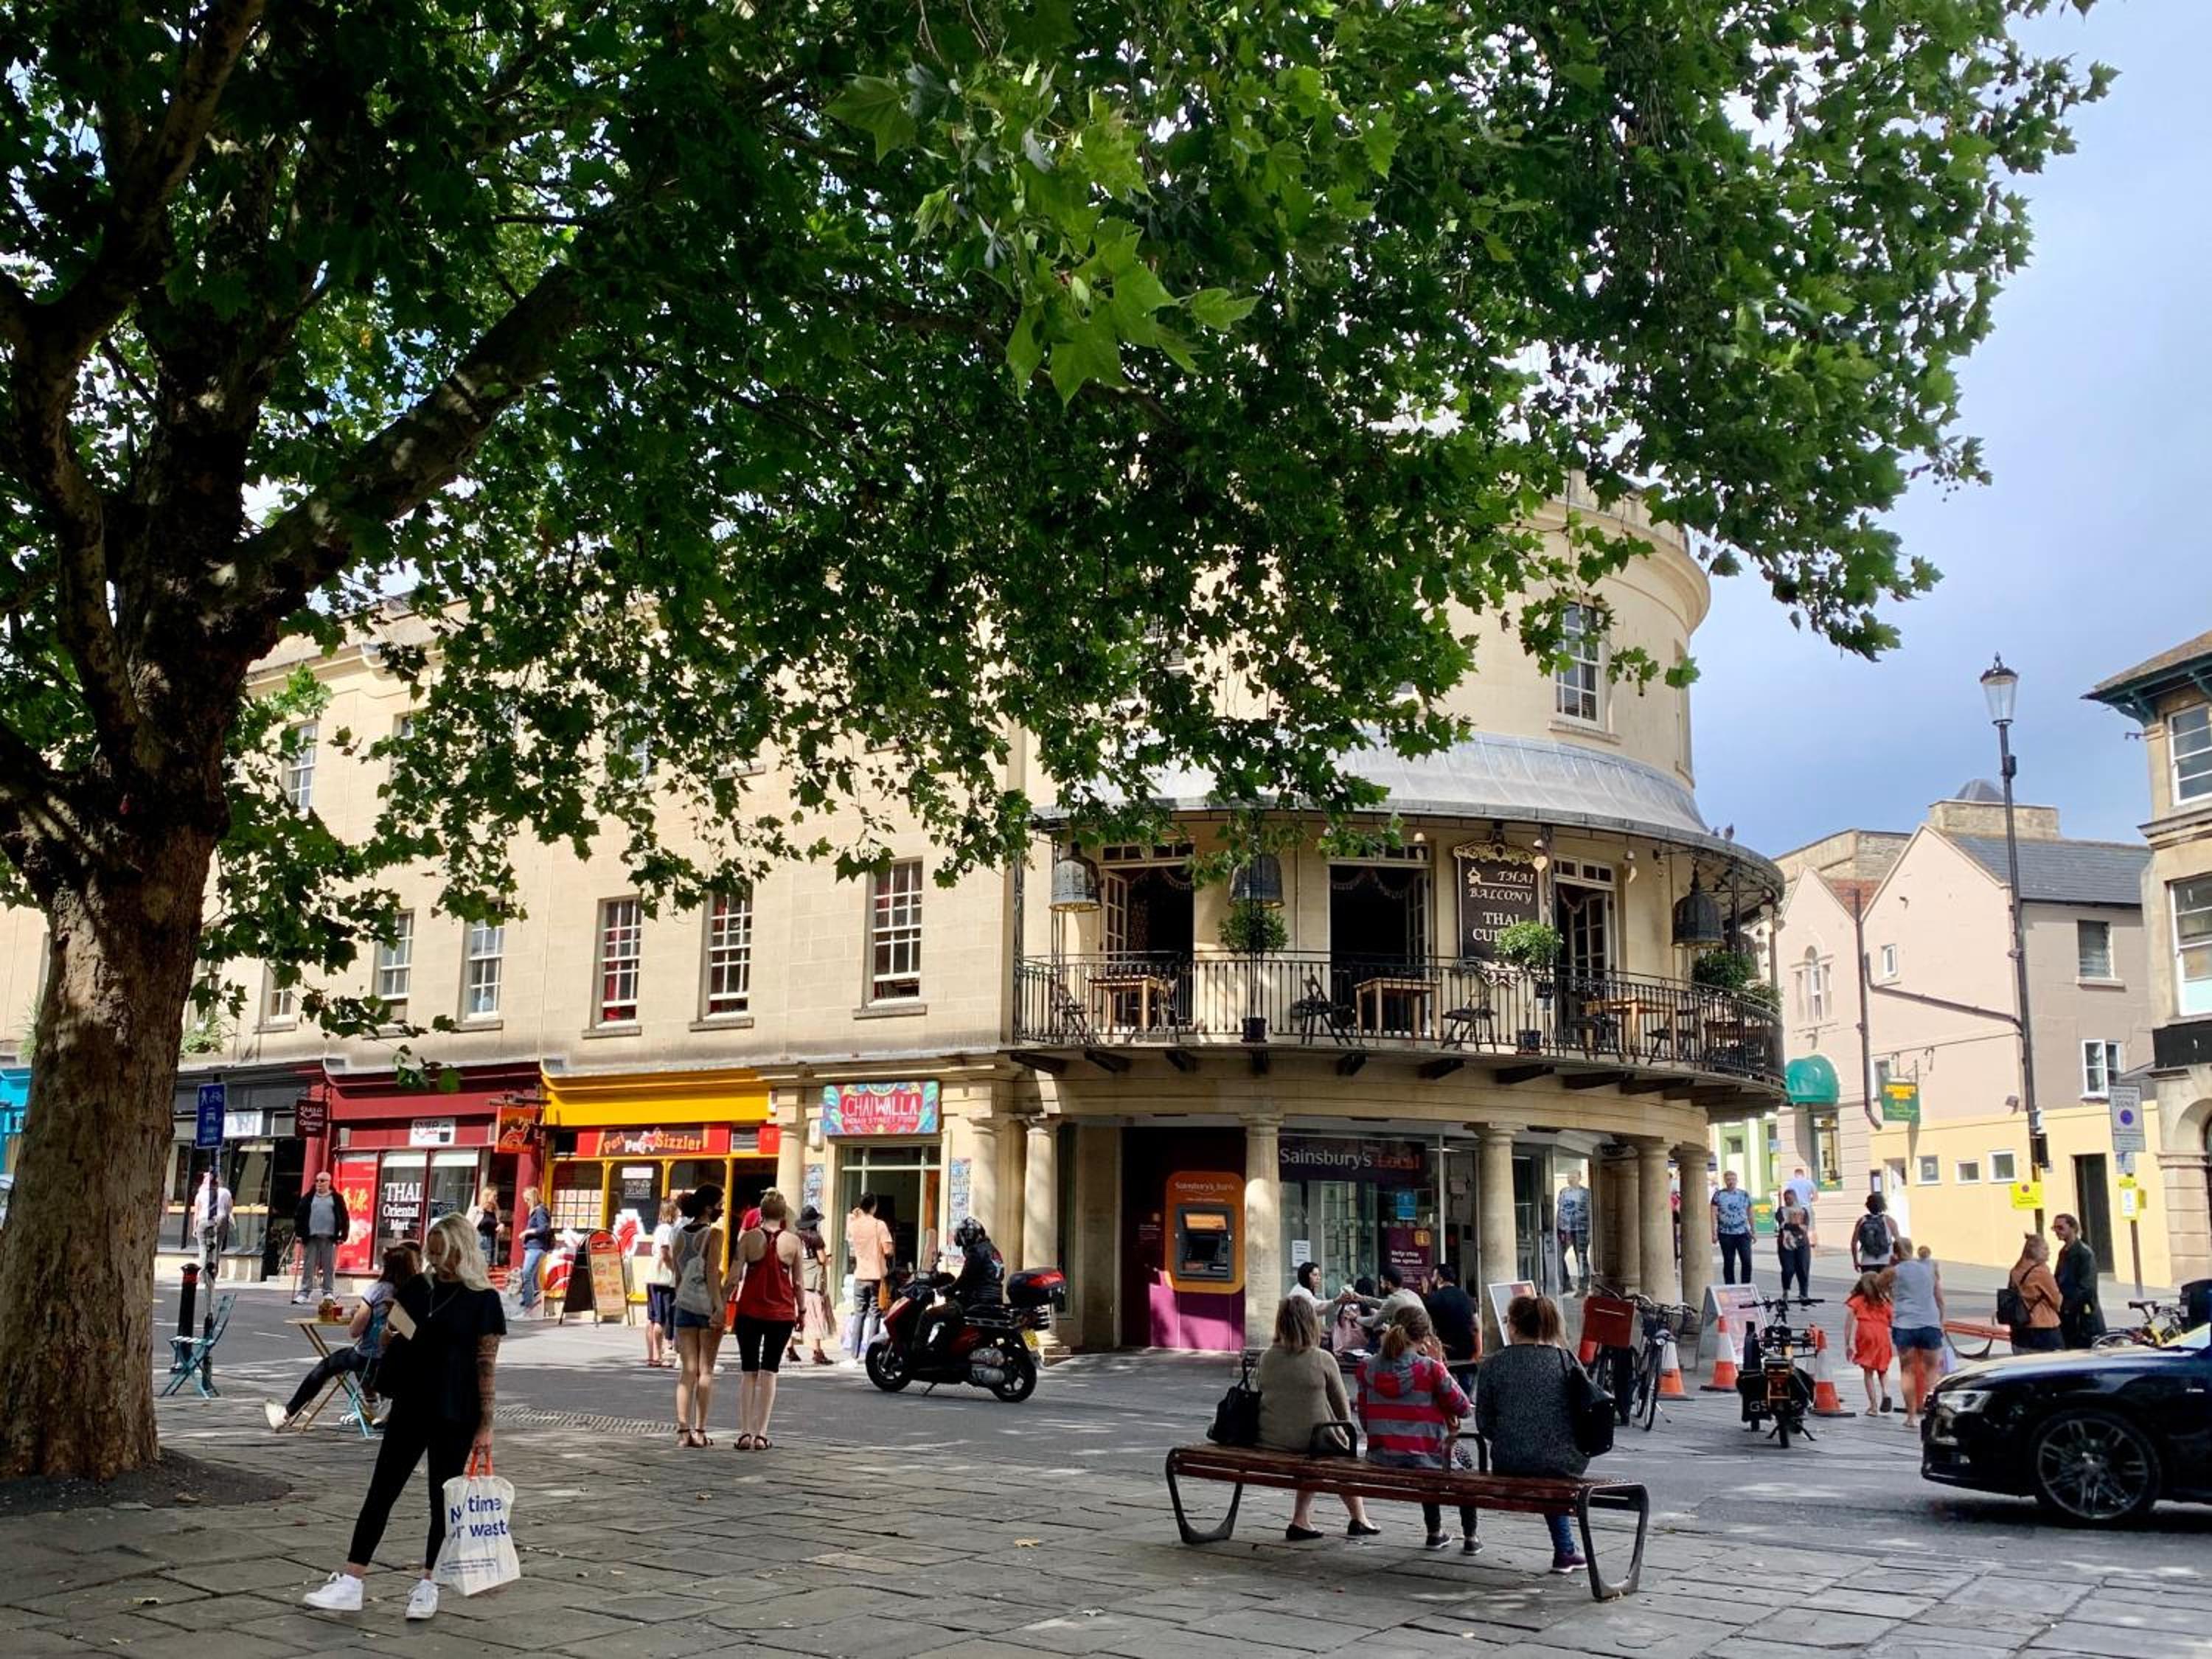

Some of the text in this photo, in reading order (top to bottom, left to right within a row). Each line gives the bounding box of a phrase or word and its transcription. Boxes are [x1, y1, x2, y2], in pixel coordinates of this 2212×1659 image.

[1498, 872, 1534, 883] THAI
[1469, 888, 1533, 904] BALCONY
[1483, 911, 1520, 926] THAI
[655, 1132, 701, 1151] Sizzler
[1279, 1147, 1372, 1170] Sainsbury's
[384, 1182, 422, 1202] THAI
[383, 1204, 420, 1217] Oriental
[451, 1505, 462, 1524] N
[470, 1519, 507, 1537] wast
